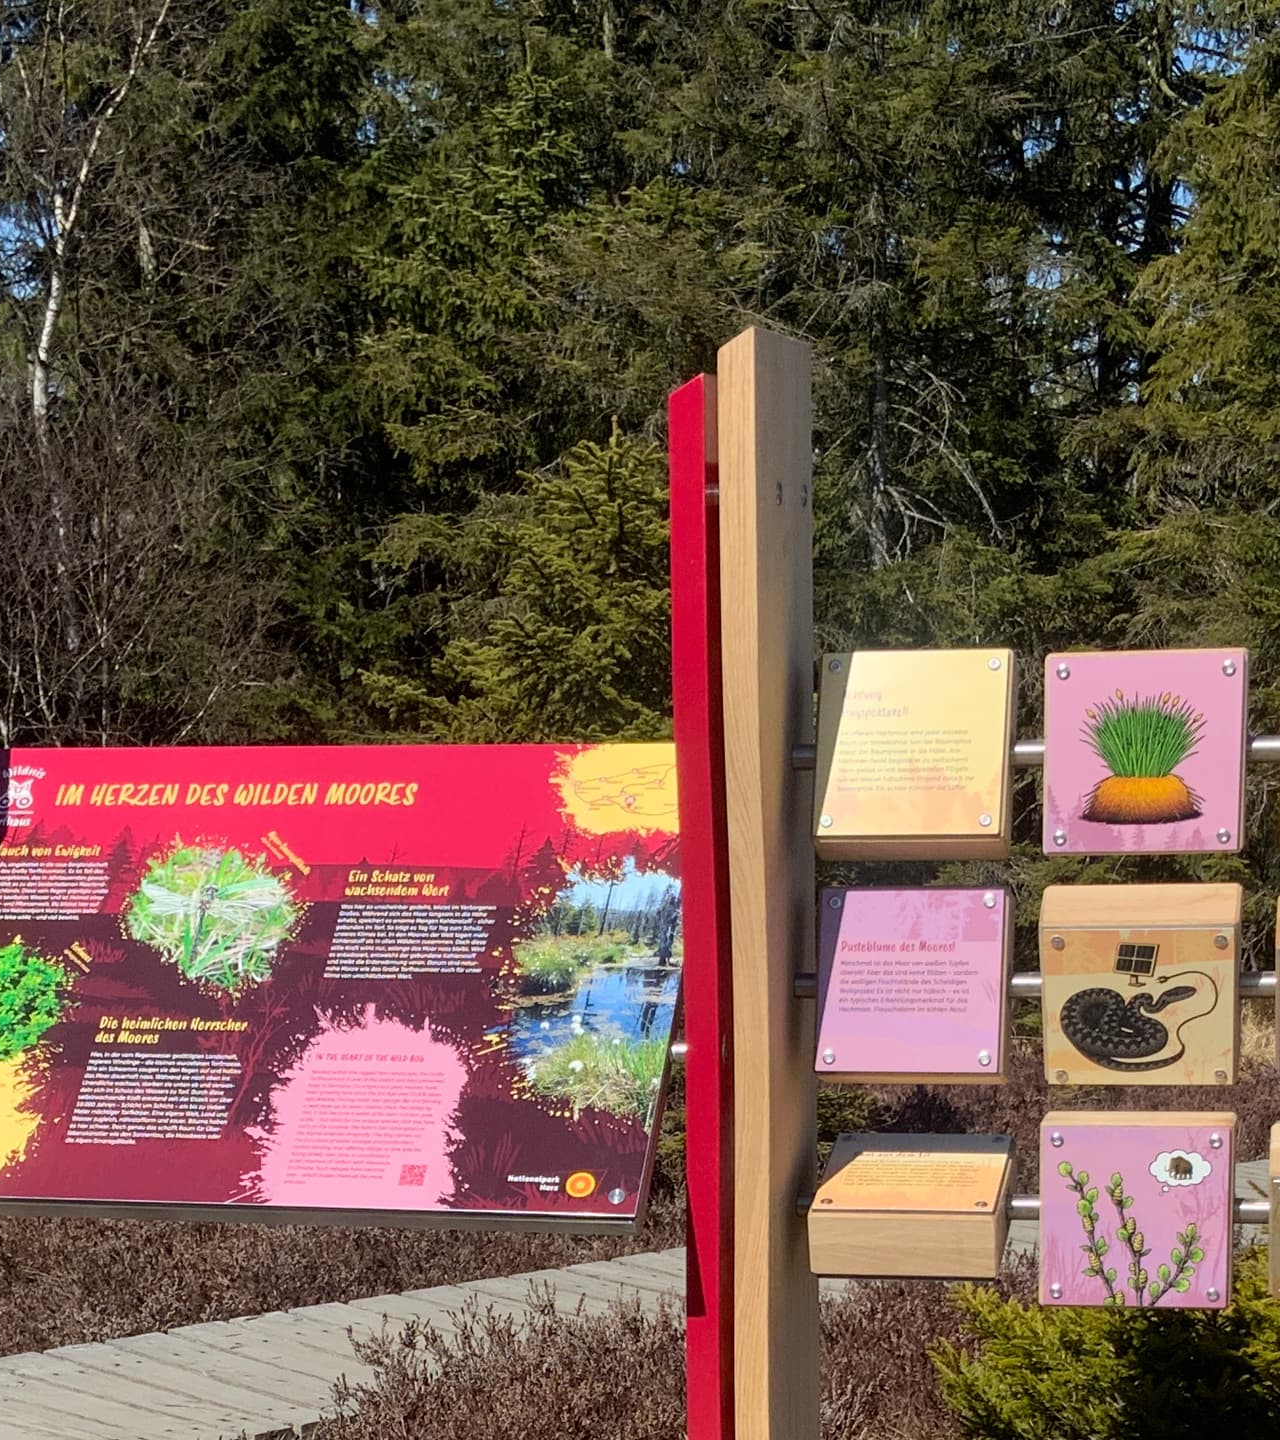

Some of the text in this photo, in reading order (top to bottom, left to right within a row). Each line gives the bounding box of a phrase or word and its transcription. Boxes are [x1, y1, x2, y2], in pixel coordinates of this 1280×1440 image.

[2, 765, 47, 780] Wildnis
[55, 782, 418, 806] IM HERZEN DES WILDEN MOORES
[31, 847, 52, 857] von
[55, 844, 101, 859] Ewigkeit
[348, 870, 435, 883] Ein Schatz von
[345, 884, 450, 896] wachsendem Wert
[841, 941, 956, 953] Pusteblume des Moores!
[99, 1016, 248, 1031] Die heimlichen Herrscher
[95, 1031, 159, 1044] des Moores
[326, 1054, 337, 1062] THE
[341, 1054, 363, 1062] HEART
[376, 1054, 388, 1062] THE
[507, 1175, 560, 1184] Nationalpark
